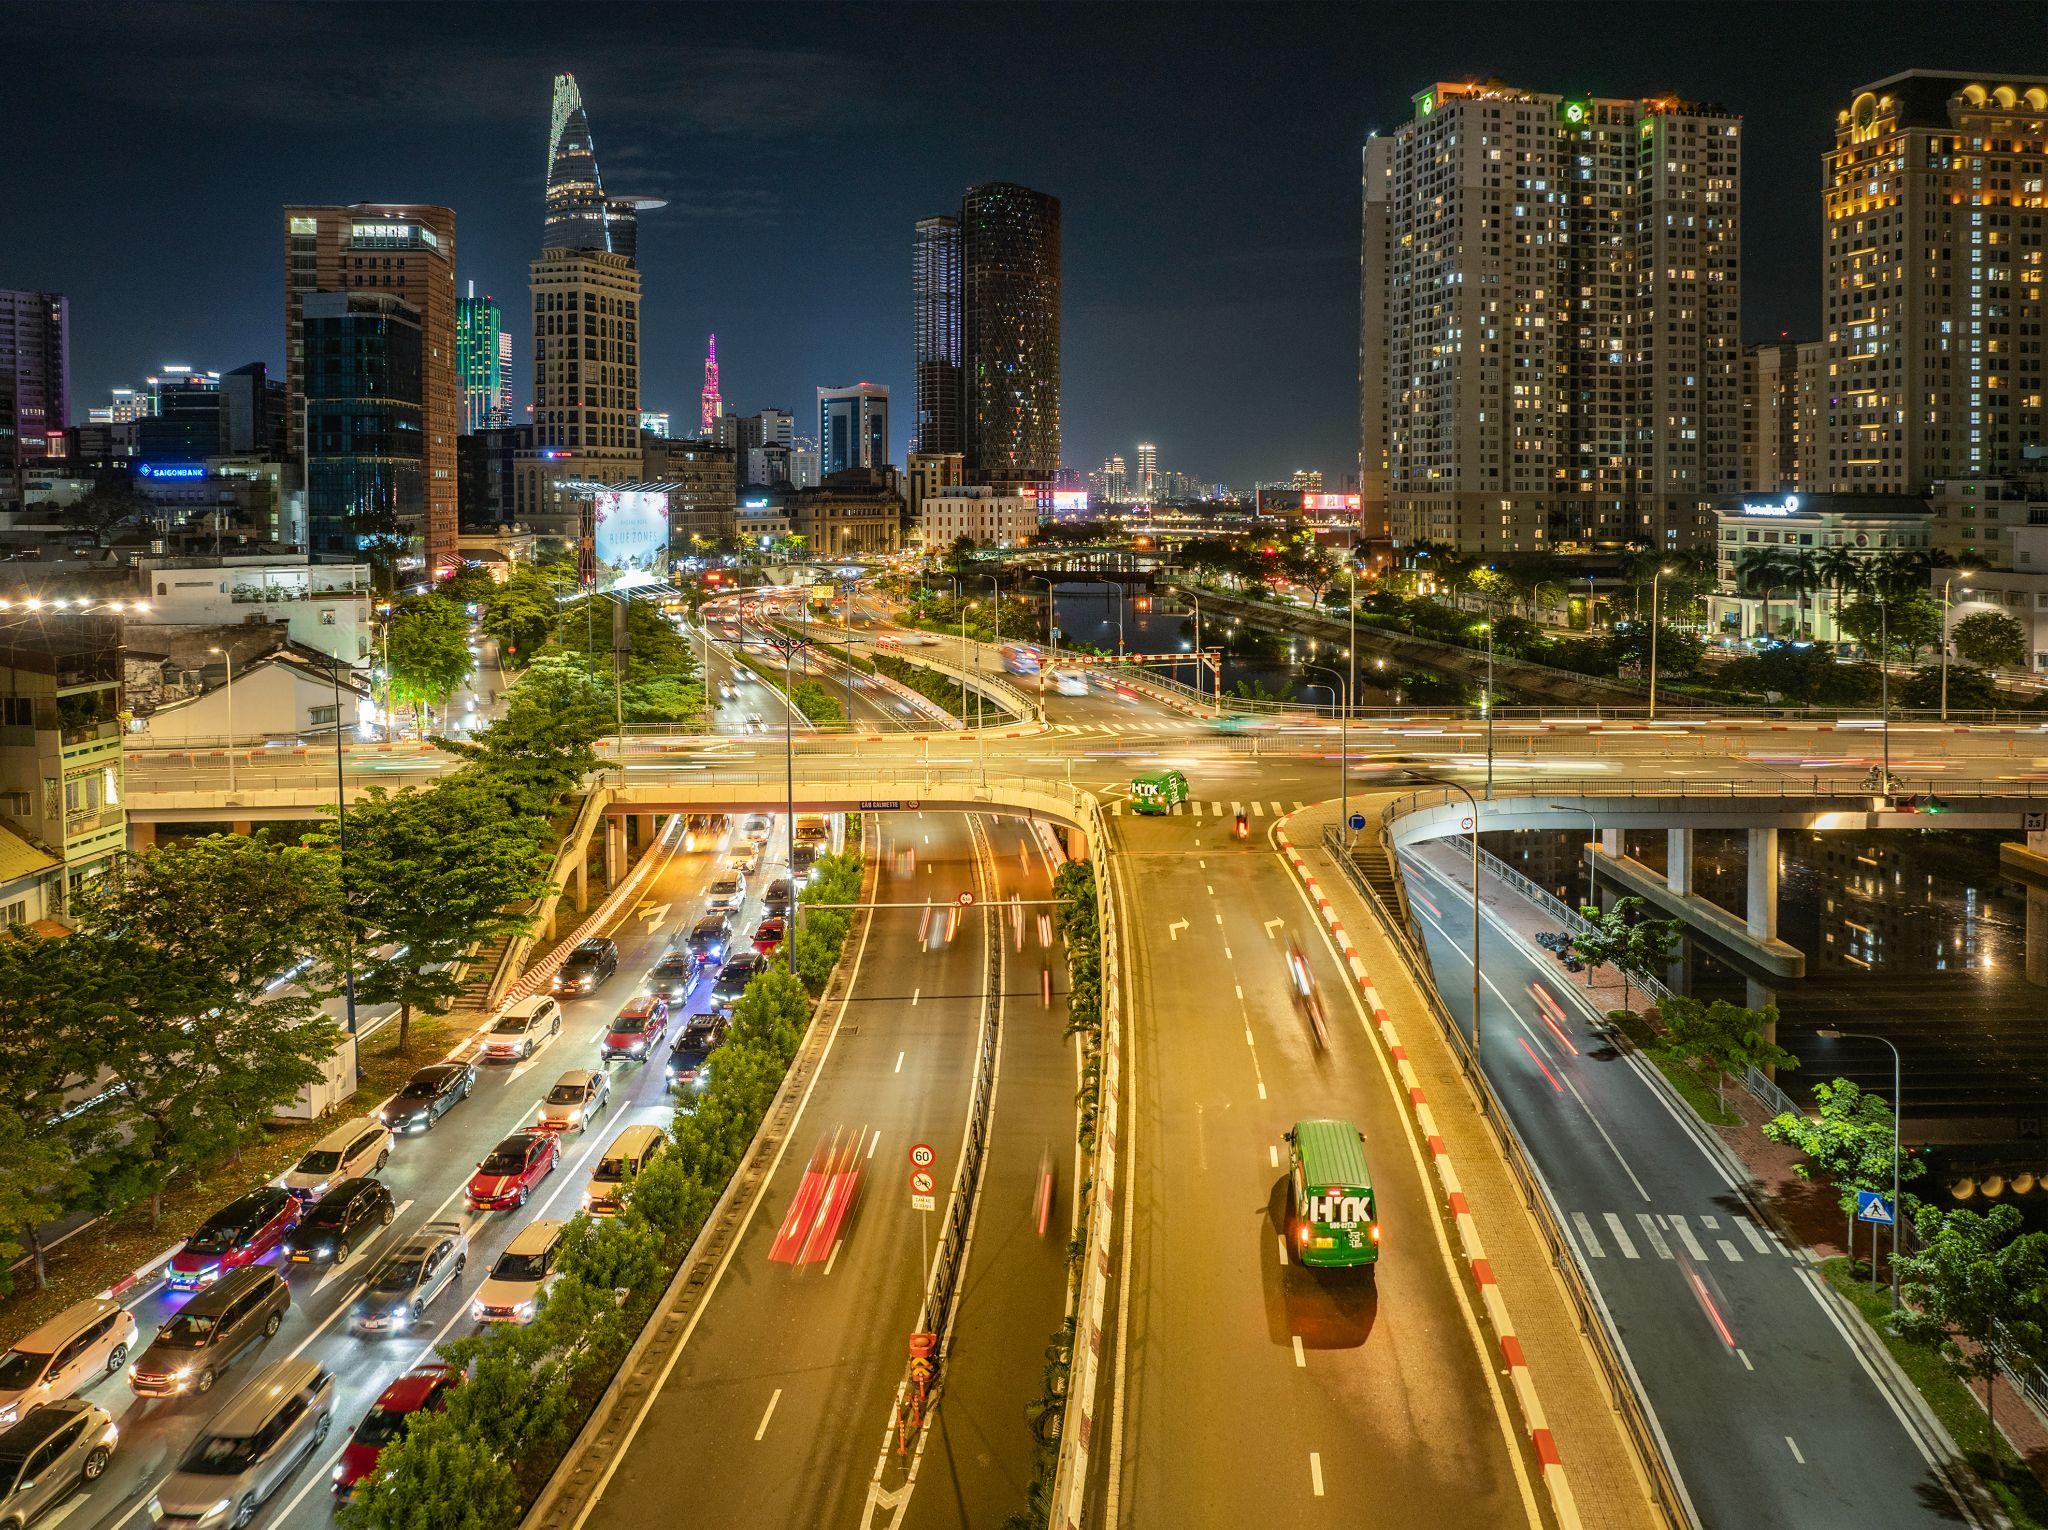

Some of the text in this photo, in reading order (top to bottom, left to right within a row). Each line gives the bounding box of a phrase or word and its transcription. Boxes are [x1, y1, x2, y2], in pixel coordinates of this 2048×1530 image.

[153, 469, 203, 477] SAIGONBANK
[609, 531, 658, 545] BLUE ZONES
[915, 1150, 930, 1162] 60
